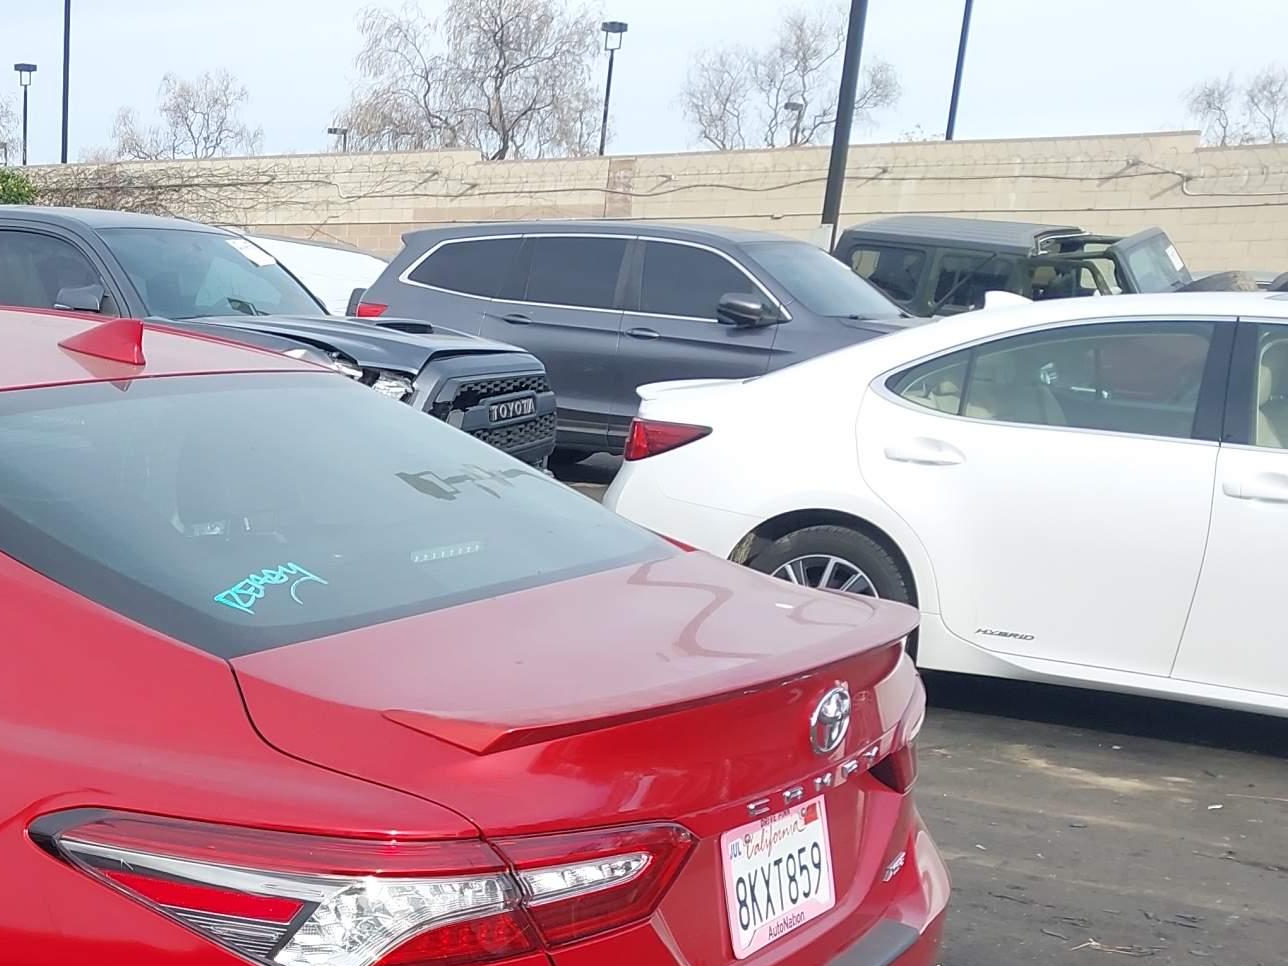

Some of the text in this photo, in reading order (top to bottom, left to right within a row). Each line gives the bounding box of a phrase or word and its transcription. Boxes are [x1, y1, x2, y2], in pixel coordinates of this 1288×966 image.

[490, 397, 535, 421] TOYOTA
[974, 628, 1035, 640] HYBRID
[743, 818, 808, 860] California
[735, 841, 822, 931] 8KXT859
[768, 911, 805, 940] AutoNation
